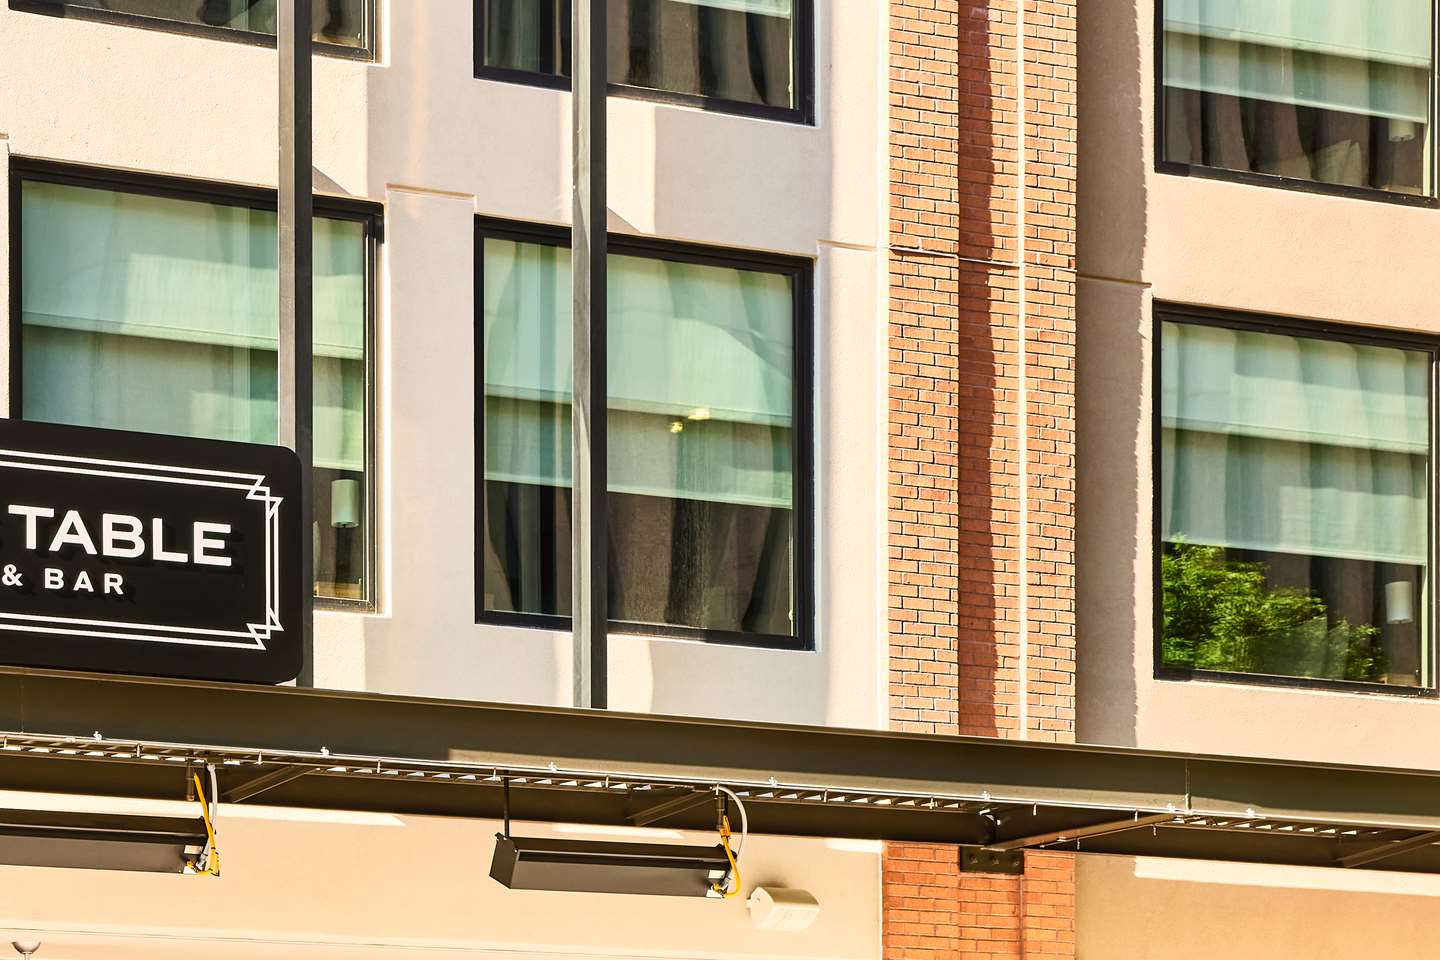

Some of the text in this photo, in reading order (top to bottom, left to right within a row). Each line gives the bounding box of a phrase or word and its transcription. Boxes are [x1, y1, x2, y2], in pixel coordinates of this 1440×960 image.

[7, 504, 233, 567] TABLE
[1, 563, 24, 587] &
[44, 567, 125, 595] BAR
